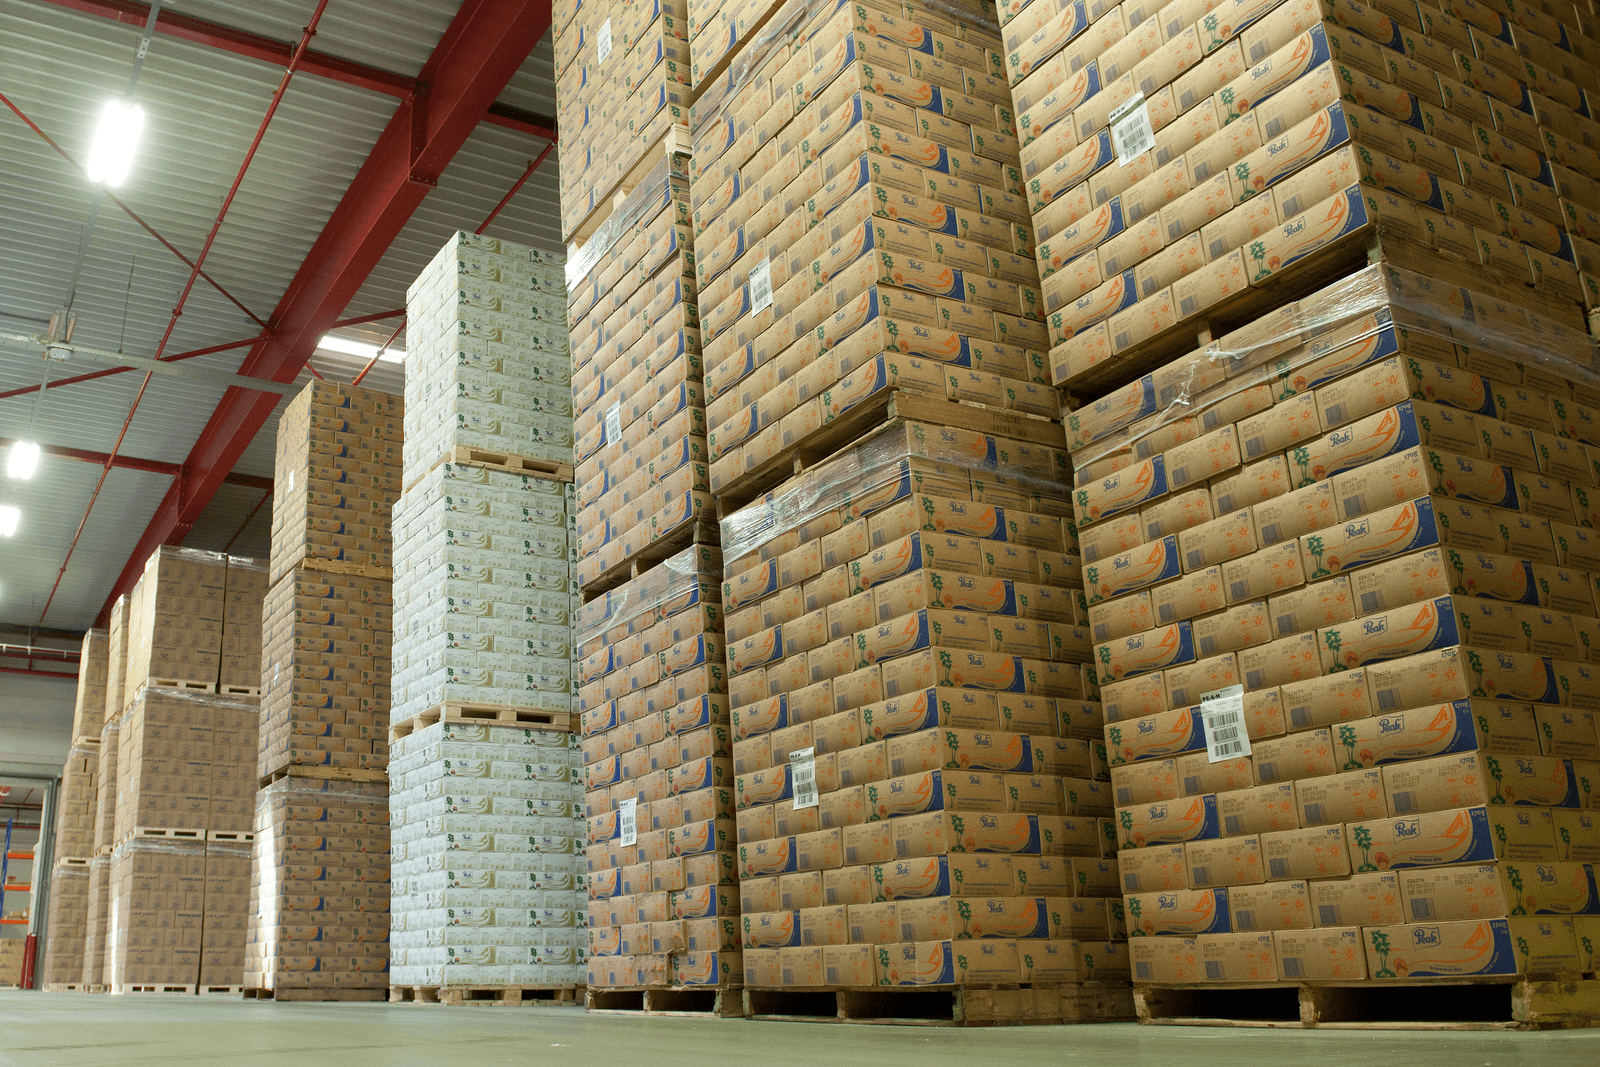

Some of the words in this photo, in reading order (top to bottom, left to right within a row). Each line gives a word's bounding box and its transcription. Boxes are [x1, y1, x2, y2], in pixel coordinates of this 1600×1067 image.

[1033, 30, 1046, 46] Peak
[1252, 64, 1270, 81] Peak
[1044, 94, 1057, 109] Peak
[1267, 141, 1286, 157] Peak
[1054, 159, 1068, 174] Peak
[902, 195, 916, 206] Peak
[1064, 227, 1078, 241] Peak
[1284, 222, 1304, 238] Peak
[908, 260, 923, 271] Peak
[1076, 296, 1090, 310] Peak
[914, 326, 928, 337] Peak
[1384, 358, 1397, 366] 170g
[1299, 394, 1311, 402] 170g
[1398, 403, 1411, 411] 170g
[1330, 432, 1351, 448] Peak
[1404, 451, 1418, 459] 170g
[1103, 480, 1118, 492] Peak
[1316, 483, 1329, 491] 170g
[950, 502, 964, 513] Peak
[1346, 524, 1366, 539] Peak
[872, 552, 884, 564] Peak
[1423, 550, 1438, 558] 170g
[1114, 557, 1128, 570] Peak
[958, 576, 973, 588] Peak
[879, 626, 890, 638] Peak
[1364, 620, 1385, 635] Peak
[1126, 638, 1142, 650] Peak
[968, 654, 983, 666] Peak
[886, 703, 898, 715] Peak
[1138, 722, 1154, 734] Peak
[1379, 718, 1401, 733] Peak
[974, 733, 990, 746] Peak
[890, 782, 903, 794] Peak
[1150, 806, 1166, 819] Peak
[980, 816, 996, 828] Peak
[1394, 822, 1417, 837] Peak
[897, 864, 909, 874] Peak
[988, 900, 1003, 913] Peak
[1158, 896, 1175, 908] Peak
[1492, 922, 1507, 930] 170g
[1414, 929, 1438, 944] Peak
[904, 948, 915, 960] Peak
